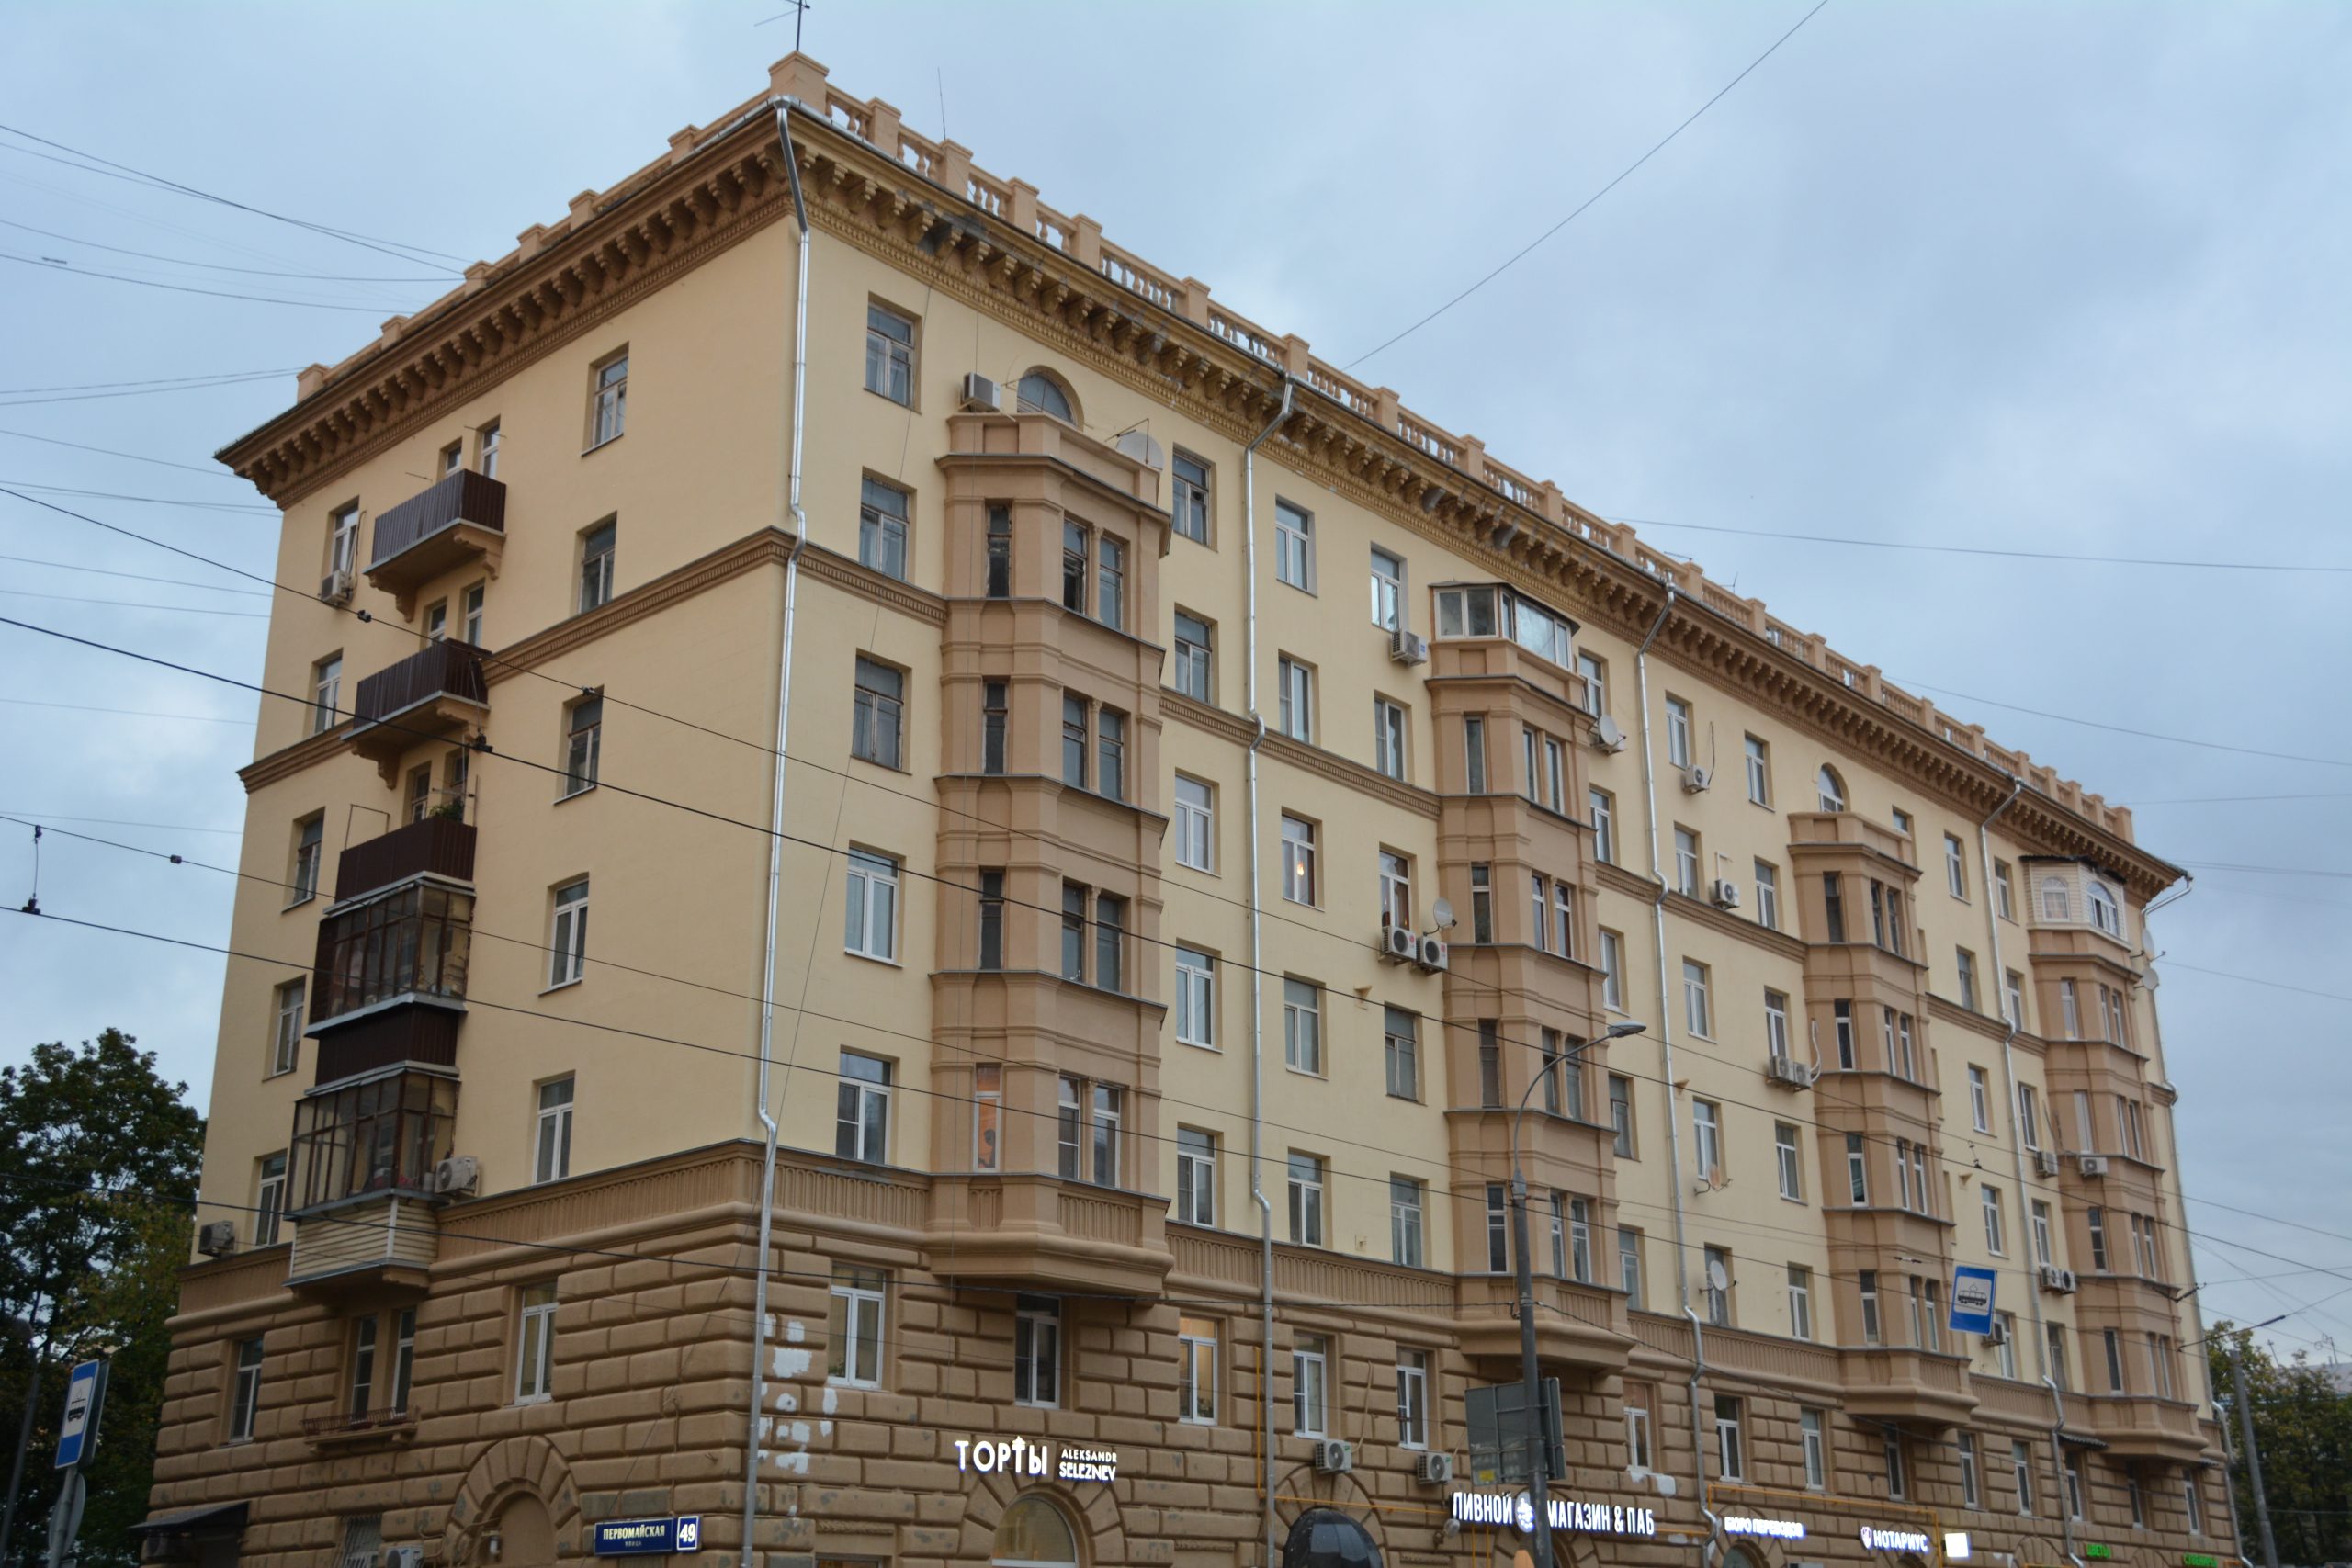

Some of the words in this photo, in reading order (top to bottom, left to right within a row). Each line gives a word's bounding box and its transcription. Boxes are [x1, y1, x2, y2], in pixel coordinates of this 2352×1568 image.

[955, 1436, 1047, 1475] ТОРТЫ
[1061, 1448, 1117, 1463] ALEKSANDR
[1059, 1461, 1116, 1482] SELEZNEV
[1453, 1492, 1513, 1525] ПИВНОЙ
[1613, 1506, 1624, 1533] &
[1626, 1506, 1655, 1535] ПАБ
[603, 1524, 665, 1540] ПЕРВОМАЙСКАЯ
[679, 1523, 696, 1543] 49
[1872, 1529, 1928, 1553] НОТАРИУС
